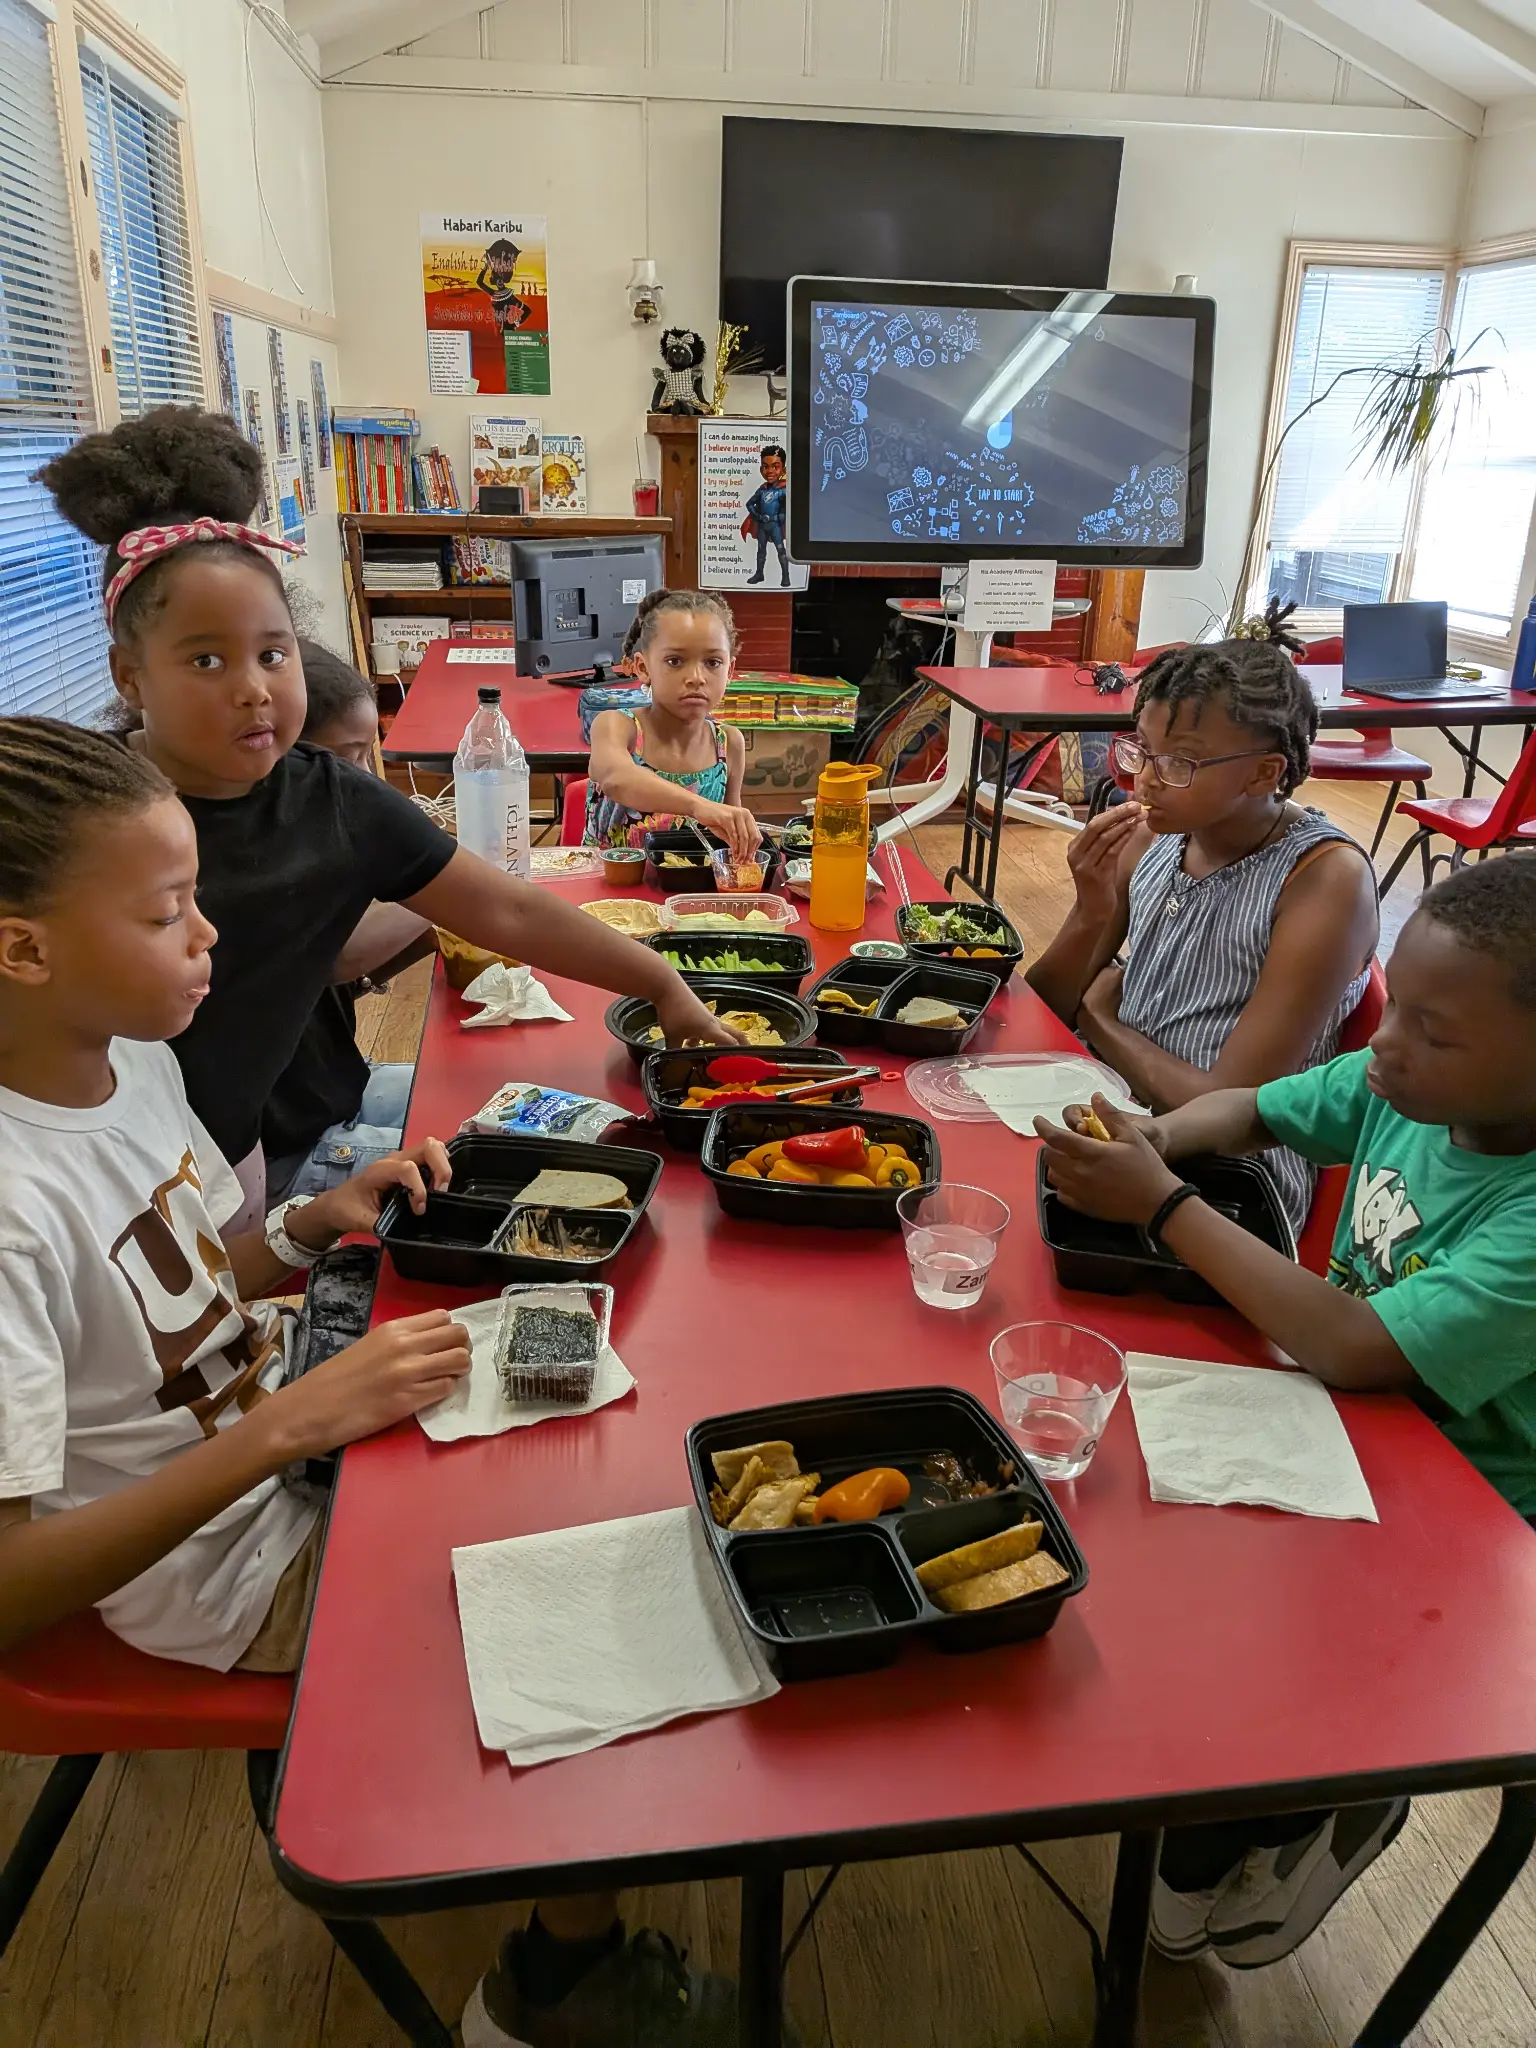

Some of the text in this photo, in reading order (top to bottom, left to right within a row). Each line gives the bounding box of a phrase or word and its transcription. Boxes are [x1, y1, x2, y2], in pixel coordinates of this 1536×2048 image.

[443, 218, 523, 234] Habari Karibu
[431, 251, 468, 272] English
[469, 255, 479, 271] to
[832, 311, 860, 319] Jamboard
[847, 319, 876, 355] COLLABORATION
[473, 424, 498, 432] MYTHS
[507, 426, 541, 434] LEGENDS
[704, 432, 707, 440] I
[731, 434, 759, 443] amazing
[760, 433, 781, 443] things.
[542, 440, 585, 454] CROLIFE
[708, 444, 731, 452] believe
[720, 456, 760, 465] unstoppable.
[728, 468, 741, 476] give
[708, 478, 717, 487] try
[719, 490, 741, 499] strong.
[978, 488, 1023, 502] TAP TO START
[718, 556, 743, 564] enough.
[708, 565, 732, 573] believe
[507, 804, 519, 875] ICELAN
[525, 1095, 560, 1124] SEAWEED
